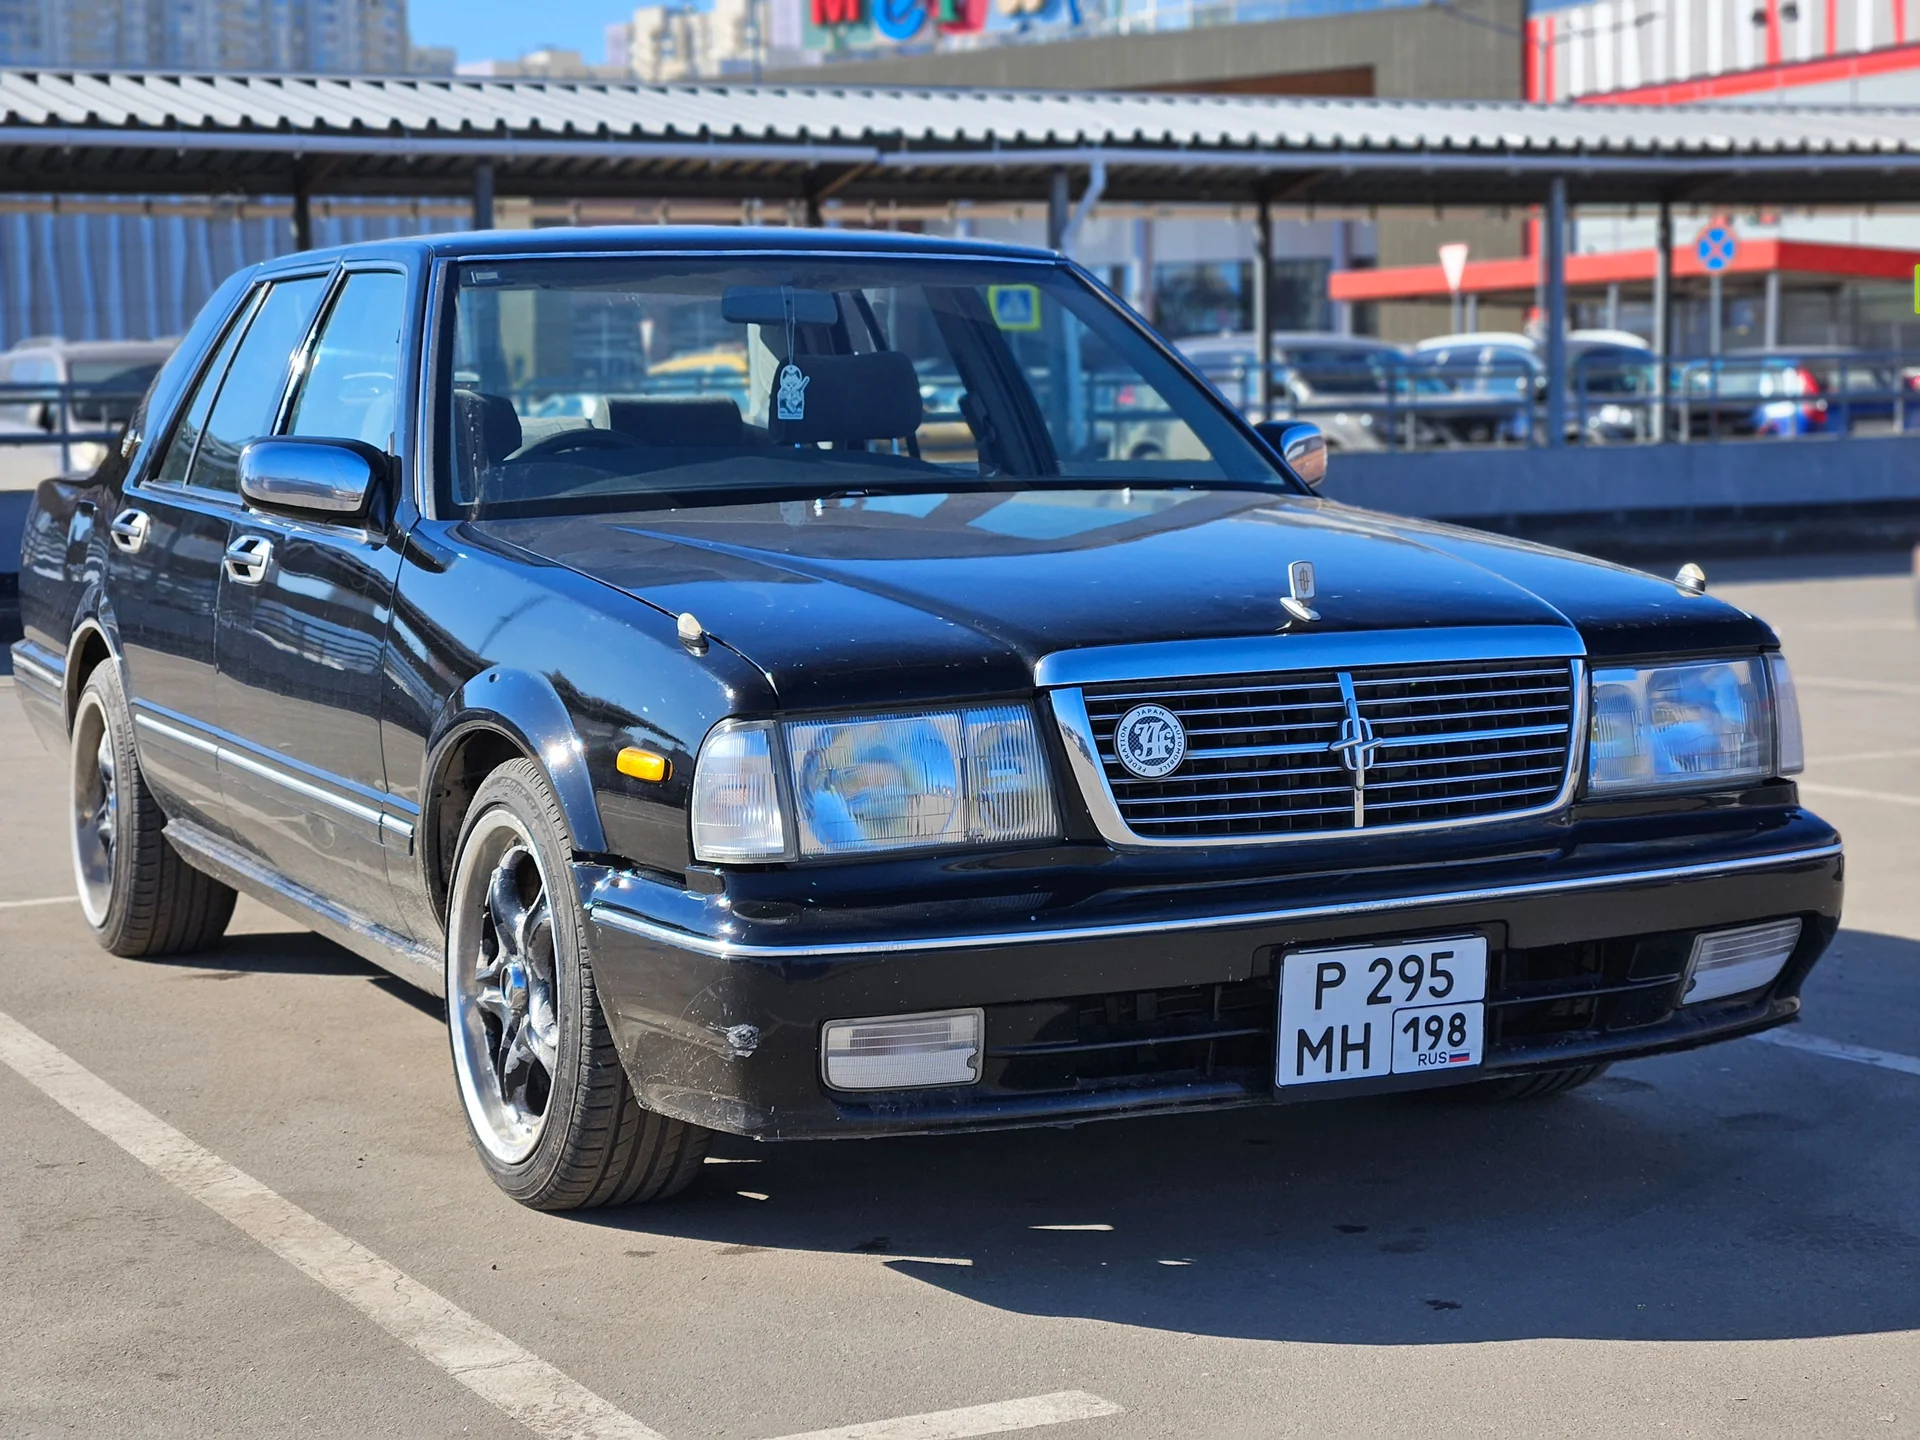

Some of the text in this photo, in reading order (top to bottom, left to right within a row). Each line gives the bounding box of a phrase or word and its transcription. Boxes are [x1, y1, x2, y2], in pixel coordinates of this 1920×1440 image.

[1136, 708, 1165, 717] JAPAN
[1120, 725, 1147, 773] FEDERATION
[1366, 951, 1454, 1006] 295
[1402, 1012, 1467, 1053] 198
[1417, 1051, 1448, 1067] RUS
